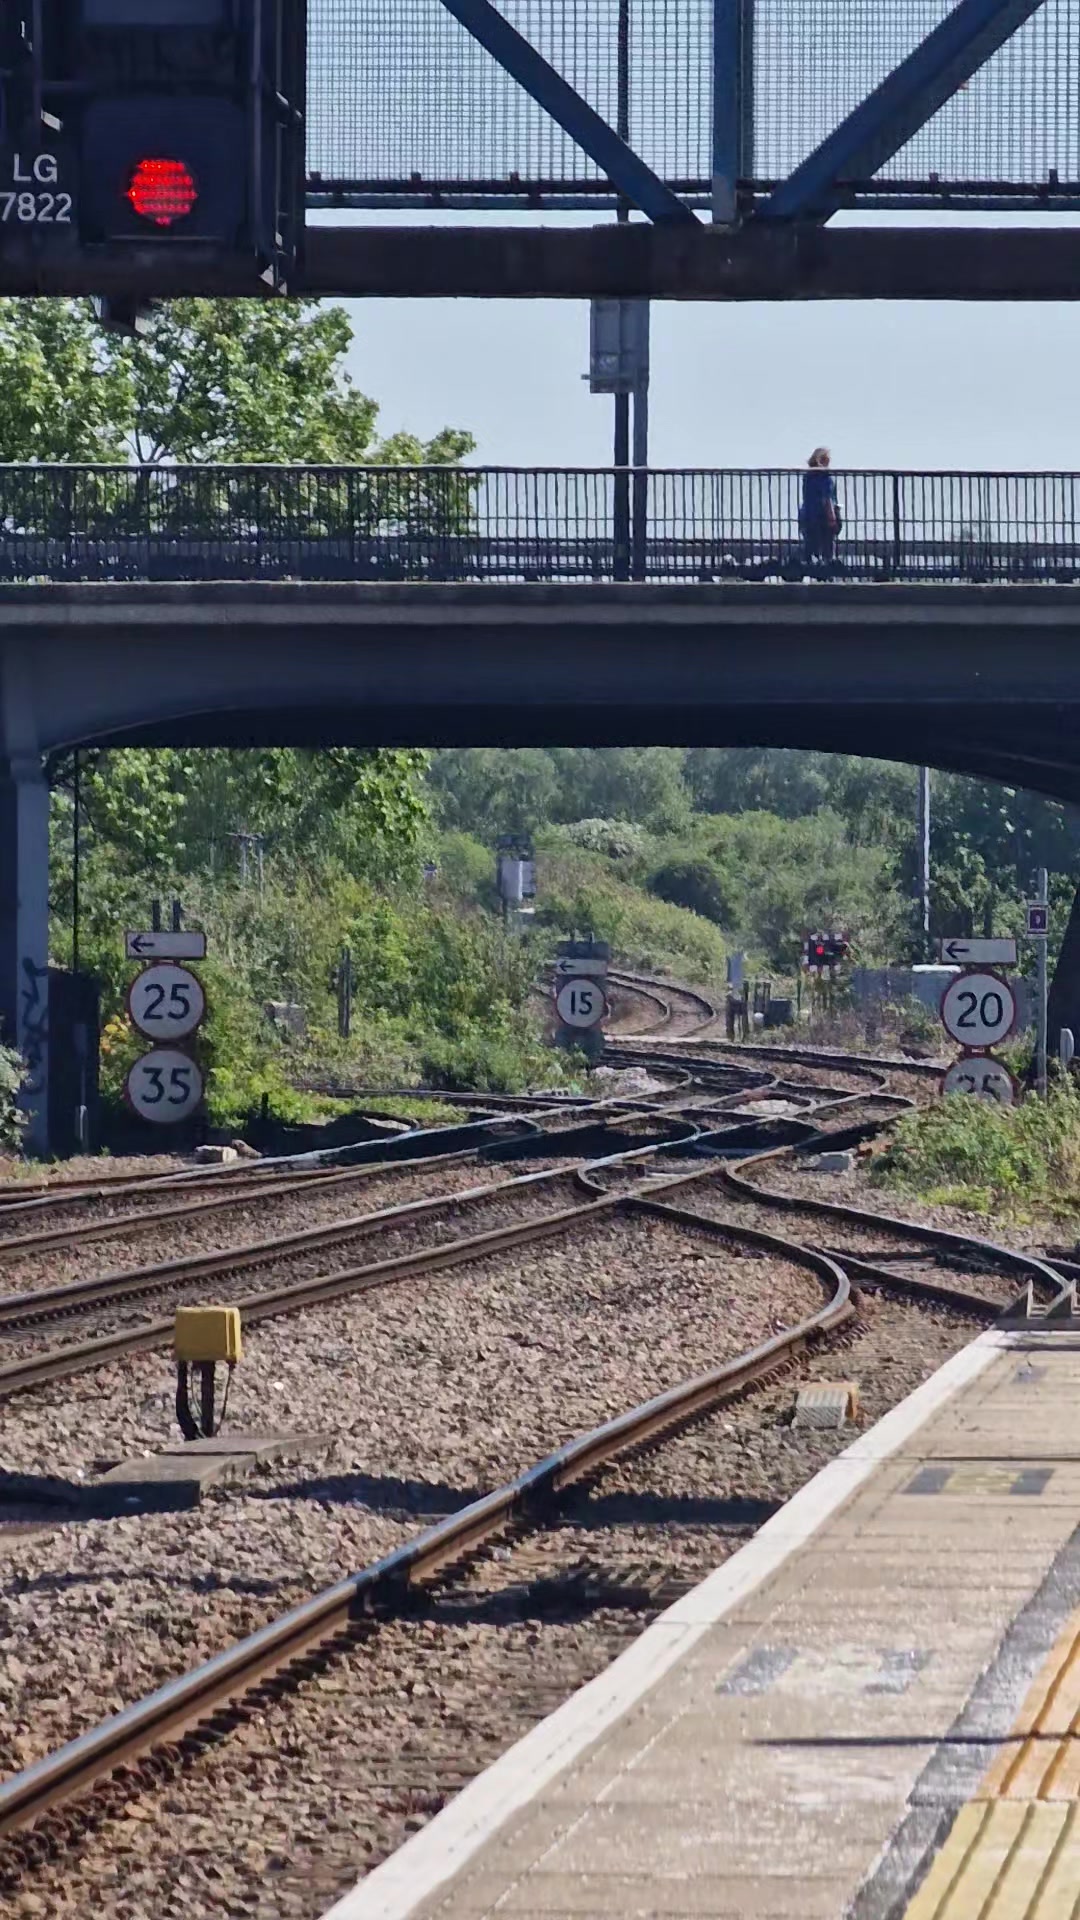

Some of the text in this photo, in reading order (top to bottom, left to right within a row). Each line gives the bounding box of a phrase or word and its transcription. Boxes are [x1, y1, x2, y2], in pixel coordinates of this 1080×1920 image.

[13, 153, 58, 183] LG
[0, 192, 72, 222] 7822
[143, 983, 190, 1020] 25
[570, 991, 593, 1015] 15
[956, 991, 1003, 1028] 20
[141, 1067, 191, 1104] 35
